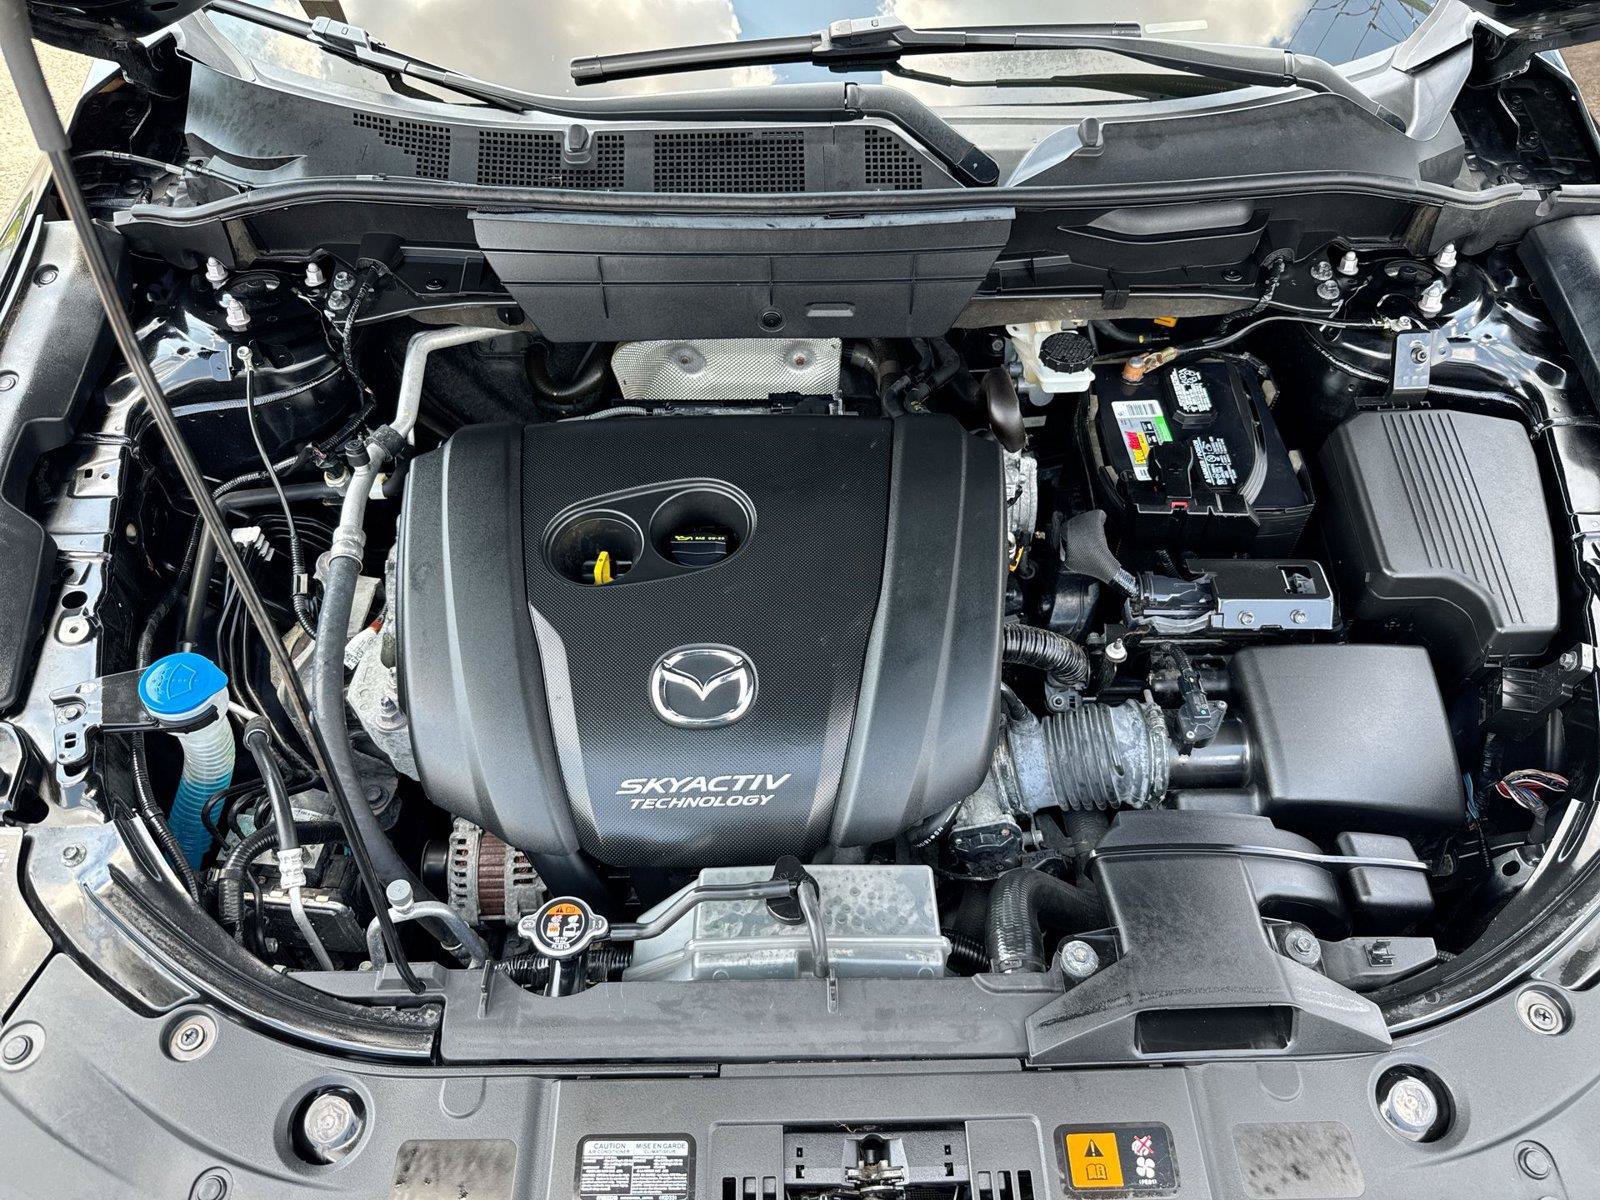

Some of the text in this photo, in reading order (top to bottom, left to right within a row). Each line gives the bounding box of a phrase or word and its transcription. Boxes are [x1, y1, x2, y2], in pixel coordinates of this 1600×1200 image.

[615, 773, 792, 795] SKYACTIV
[630, 794, 776, 810] TECHNOLOGY
[593, 1142, 626, 1150] CAUTION
